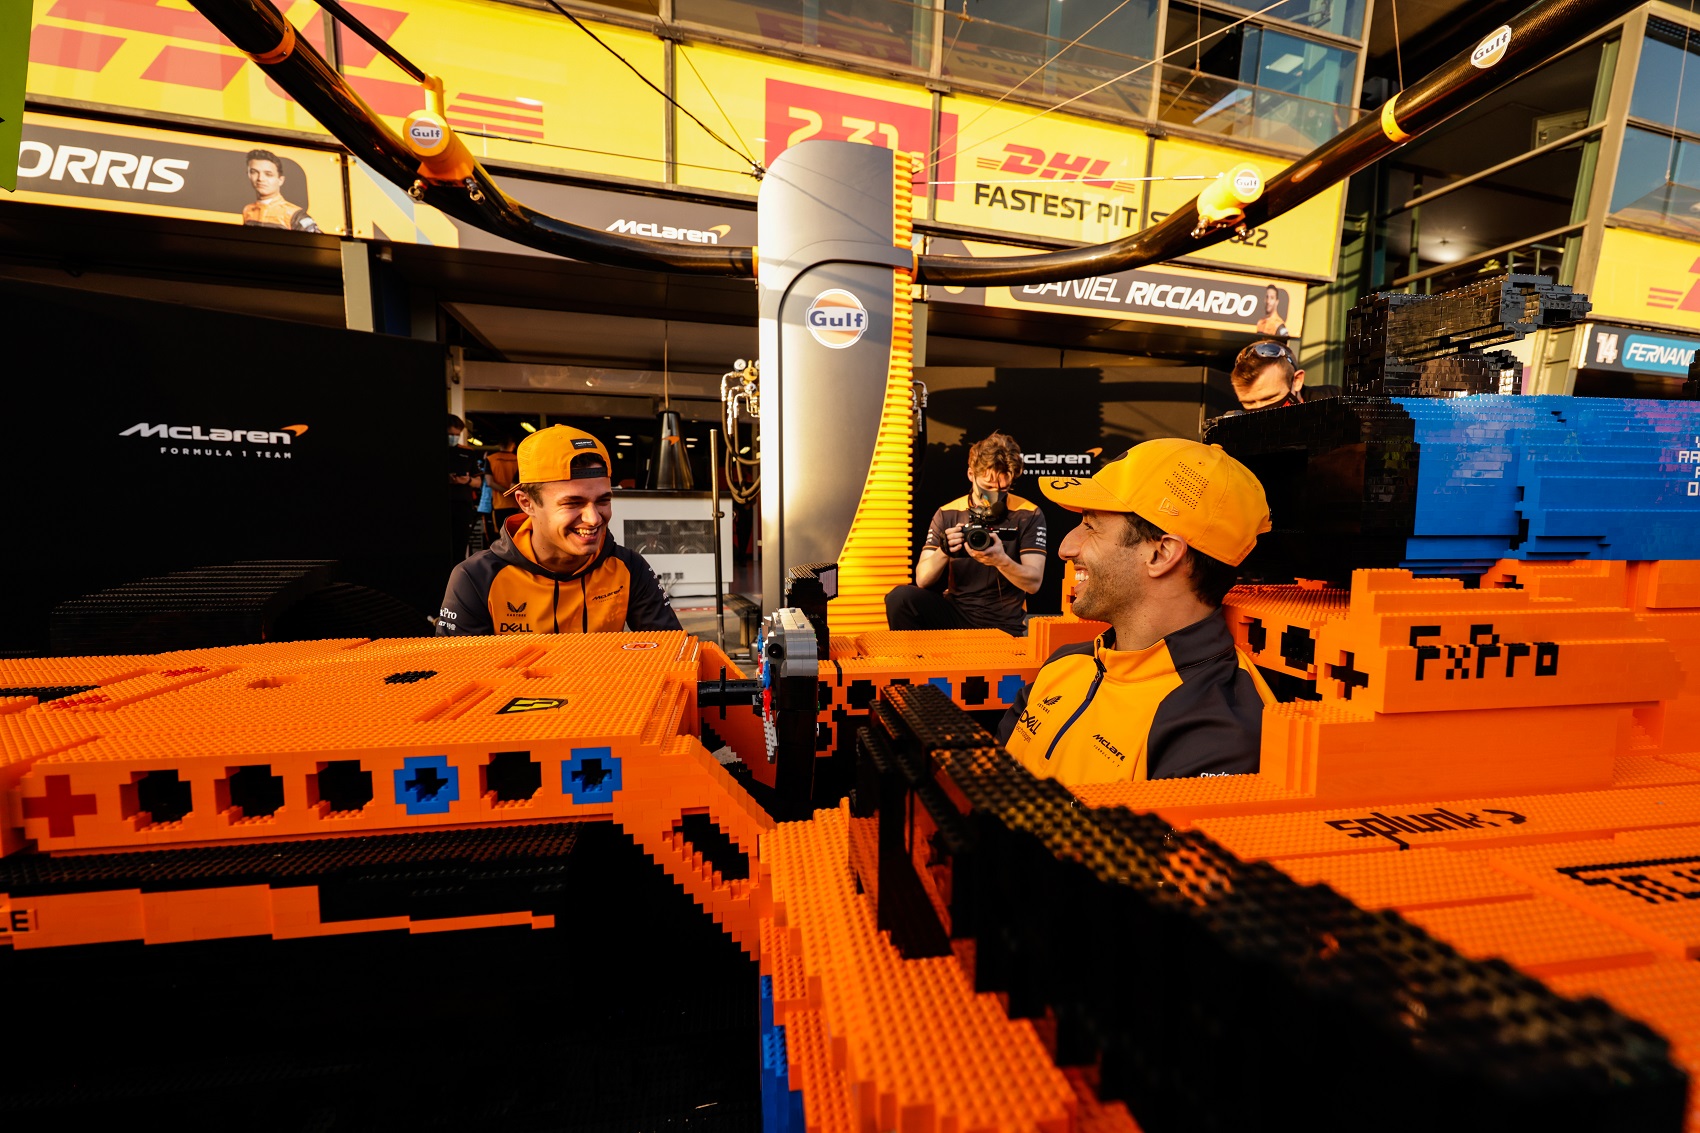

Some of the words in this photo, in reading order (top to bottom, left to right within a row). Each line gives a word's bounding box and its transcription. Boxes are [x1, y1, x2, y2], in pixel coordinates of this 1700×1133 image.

[1473, 32, 1508, 60] Gulf
[411, 127, 441, 138] Gulf
[787, 106, 899, 150] 231
[17, 140, 190, 193] ORRIS
[1000, 143, 1114, 189] DHL
[1236, 178, 1257, 187] Gulf
[974, 183, 1092, 221] FASTEST
[1097, 202, 1138, 228] PIT
[605, 218, 718, 244] McLaren
[1125, 281, 1258, 317] RICCIARDO
[809, 310, 864, 328] Gulf
[1596, 332, 1619, 364] 14
[118, 422, 292, 444] McLaren
[160, 447, 232, 457] FORMULA
[256, 451, 291, 459] TEAM
[500, 623, 533, 633] DELL
[1409, 624, 1560, 681] FxPro
[1020, 710, 1042, 735] DELL
